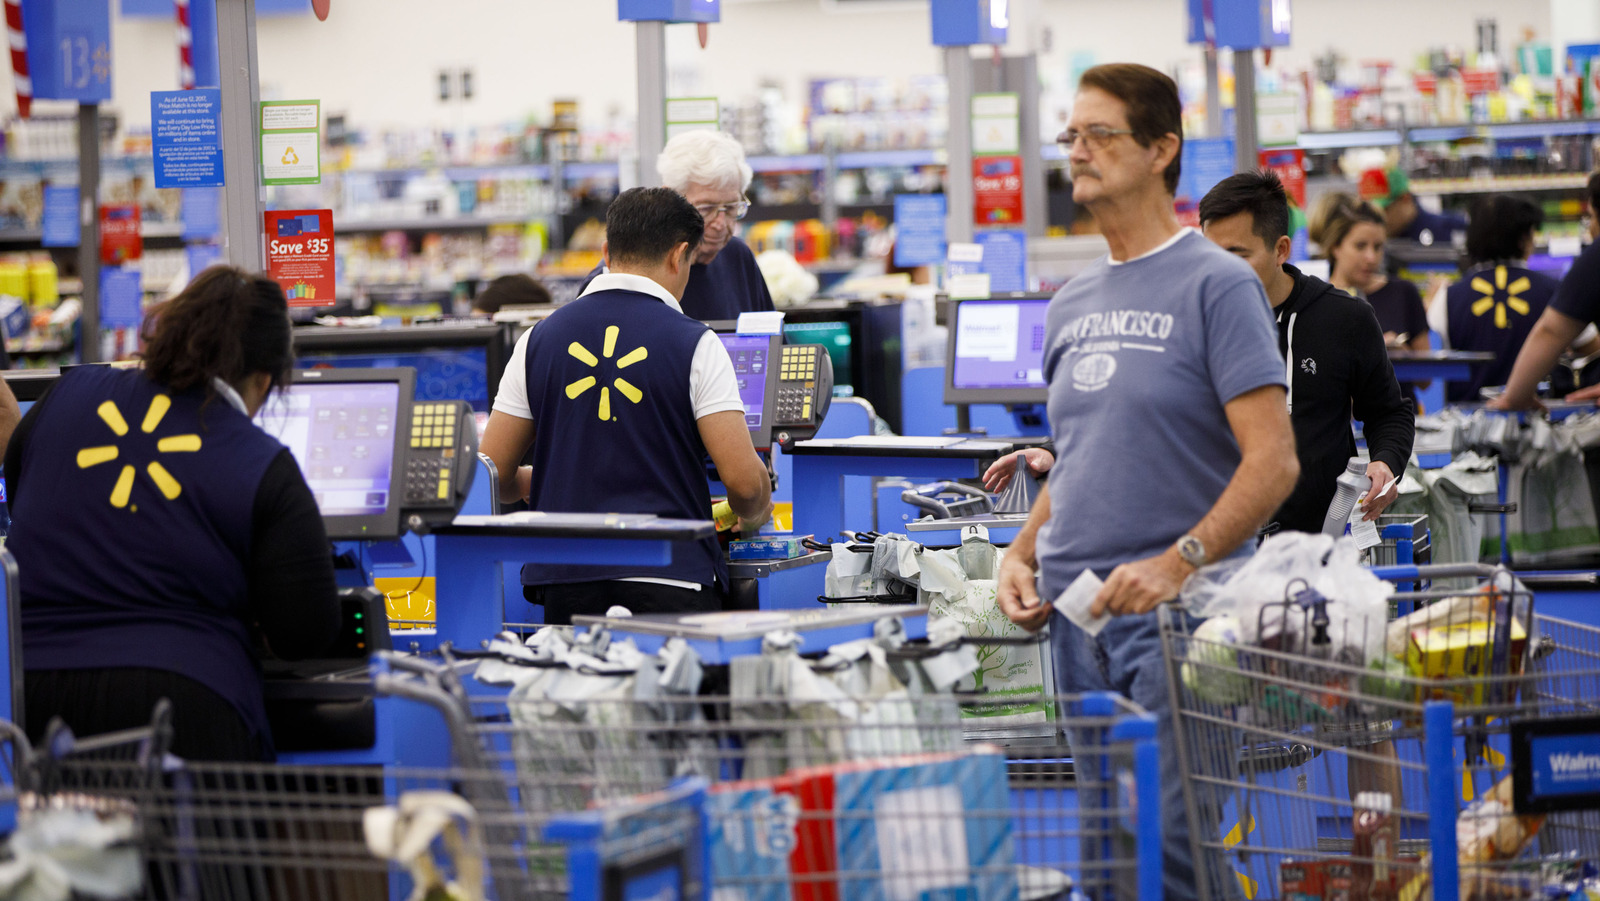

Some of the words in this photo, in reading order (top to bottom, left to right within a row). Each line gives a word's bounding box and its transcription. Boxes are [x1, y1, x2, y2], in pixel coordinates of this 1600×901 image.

[60, 37, 90, 89] 13
[270, 240, 303, 254] Save
[1080, 310, 1174, 340] FRANCISCO
